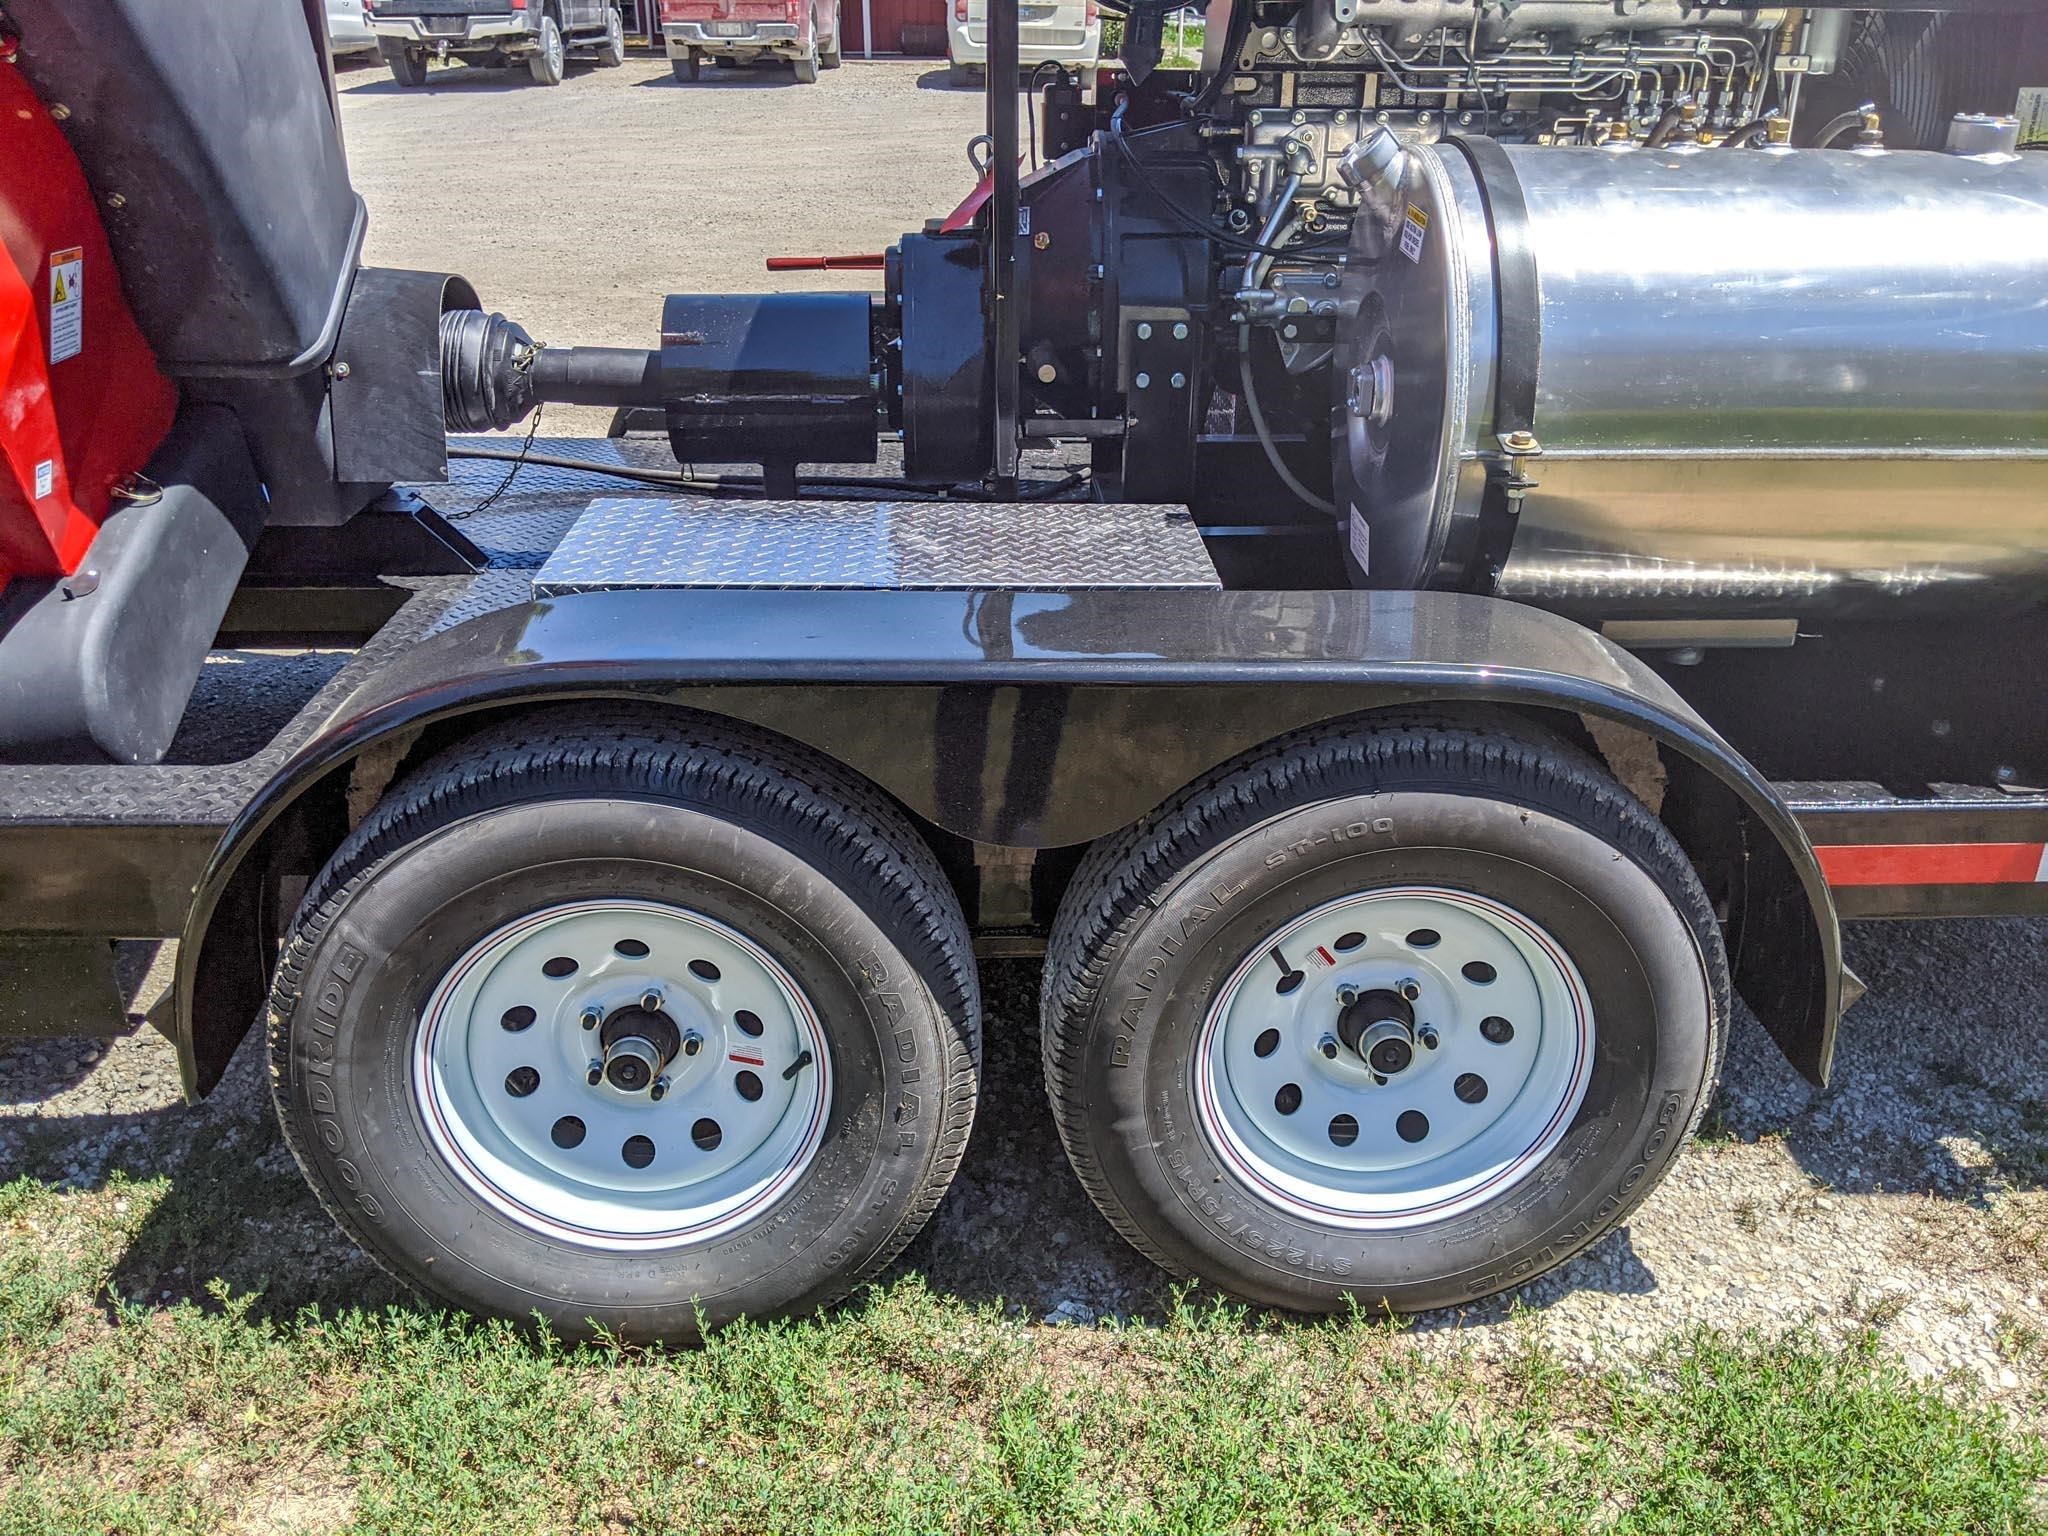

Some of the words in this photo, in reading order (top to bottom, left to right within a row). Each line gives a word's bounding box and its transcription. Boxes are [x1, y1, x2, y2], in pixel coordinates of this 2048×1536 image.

[1110, 883, 1244, 1068] RADIAL
[1264, 817, 1394, 871] ST-100
[308, 941, 384, 1223] GOODRIDE
[858, 949, 921, 1155] RADIAL
[1167, 1149, 1353, 1276] ST225/75R15
[1463, 1092, 1682, 1295] GOODRIDE
